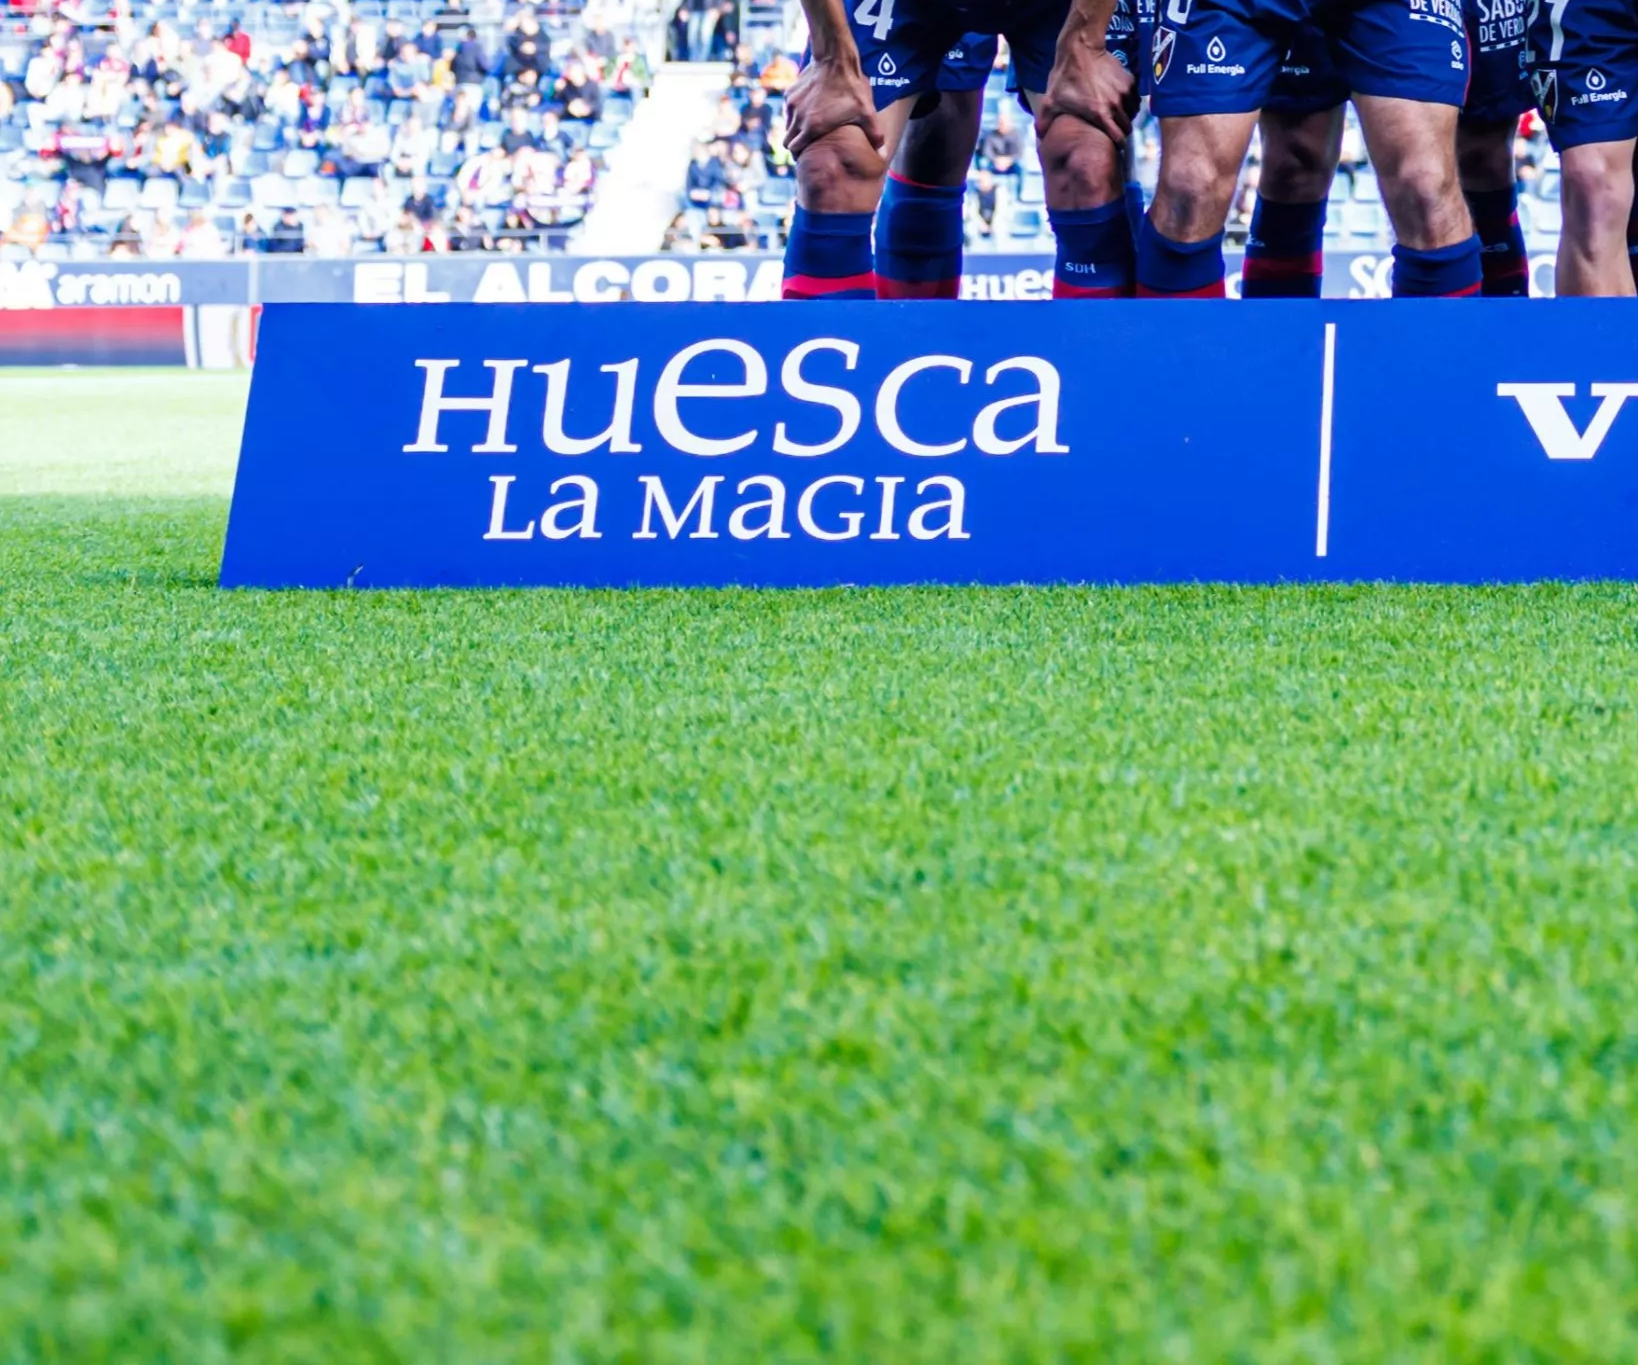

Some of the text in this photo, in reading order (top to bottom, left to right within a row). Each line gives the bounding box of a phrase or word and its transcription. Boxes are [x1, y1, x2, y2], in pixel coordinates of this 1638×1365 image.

[1479, 24, 1497, 44] DE
[1187, 64, 1206, 74] Full
[1065, 261, 1097, 274] SDH
[56, 272, 181, 305] aramon
[353, 259, 783, 303] EL ALCORA
[483, 475, 602, 540] La
